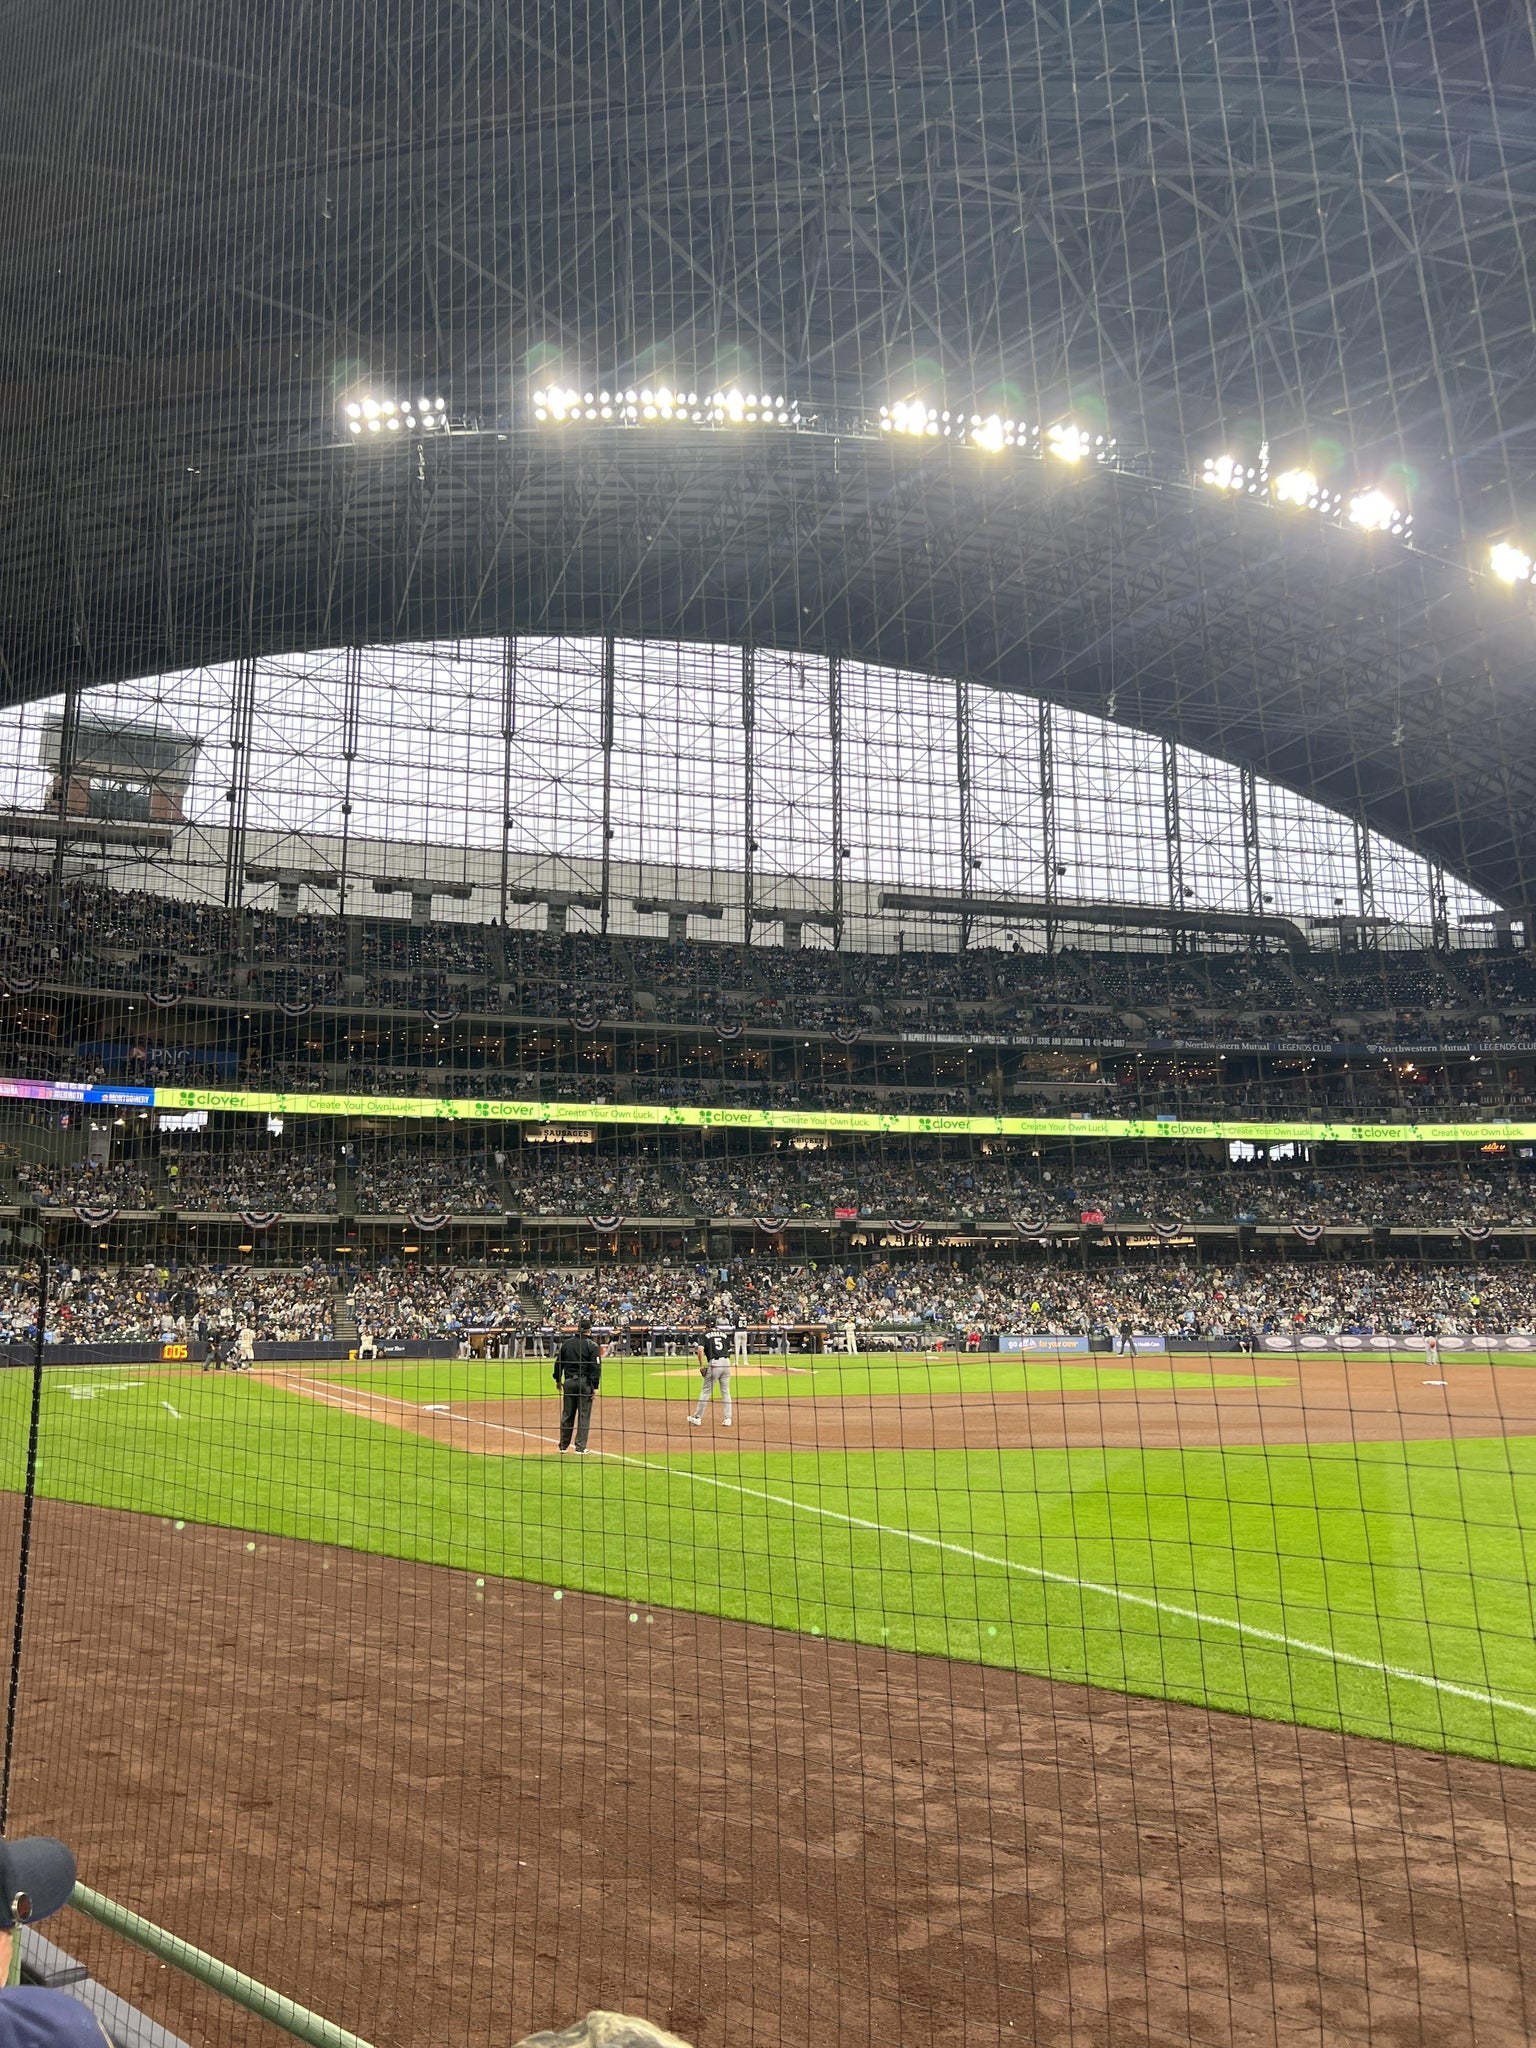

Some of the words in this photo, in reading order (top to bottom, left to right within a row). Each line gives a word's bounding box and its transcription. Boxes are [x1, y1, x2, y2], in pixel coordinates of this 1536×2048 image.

[1185, 1040, 1240, 1050] Northwestern
[1242, 1042, 1270, 1050] Mutual
[1278, 1043, 1311, 1051] LEGENDS
[1312, 1044, 1332, 1052] CLUB
[1378, 1044, 1437, 1053] Northwestern
[1439, 1043, 1470, 1052] Mutual
[1479, 1042, 1516, 1050] LEGENDS
[151, 1048, 190, 1064] PNC
[197, 1092, 245, 1106] clover
[309, 1099, 341, 1109] Create
[343, 1100, 364, 1110] Your
[367, 1101, 389, 1110] Own
[491, 1103, 533, 1116] clover
[558, 1107, 587, 1117] Create
[590, 1108, 609, 1118] Your
[611, 1109, 631, 1118] Own
[713, 1110, 752, 1123] clover
[782, 1115, 808, 1125] Create
[810, 1116, 828, 1125] Your
[830, 1117, 848, 1126] Own
[932, 1118, 970, 1129] clover
[1021, 1122, 1047, 1131] Create
[1049, 1123, 1066, 1131] Your
[1068, 1124, 1086, 1132] Own
[1171, 1123, 1207, 1134] clover
[544, 1129, 589, 1138] SAUSAGES
[1228, 1127, 1253, 1135] Create
[1255, 1127, 1273, 1135] Your
[1274, 1127, 1292, 1136] Own
[1364, 1126, 1401, 1138] clover
[1432, 1128, 1458, 1137] Create
[1460, 1128, 1479, 1137] Your
[1481, 1128, 1501, 1136] Own
[714, 1337, 723, 1350] 5
[1008, 1340, 1018, 1350] go
[1048, 1341, 1061, 1350] your
